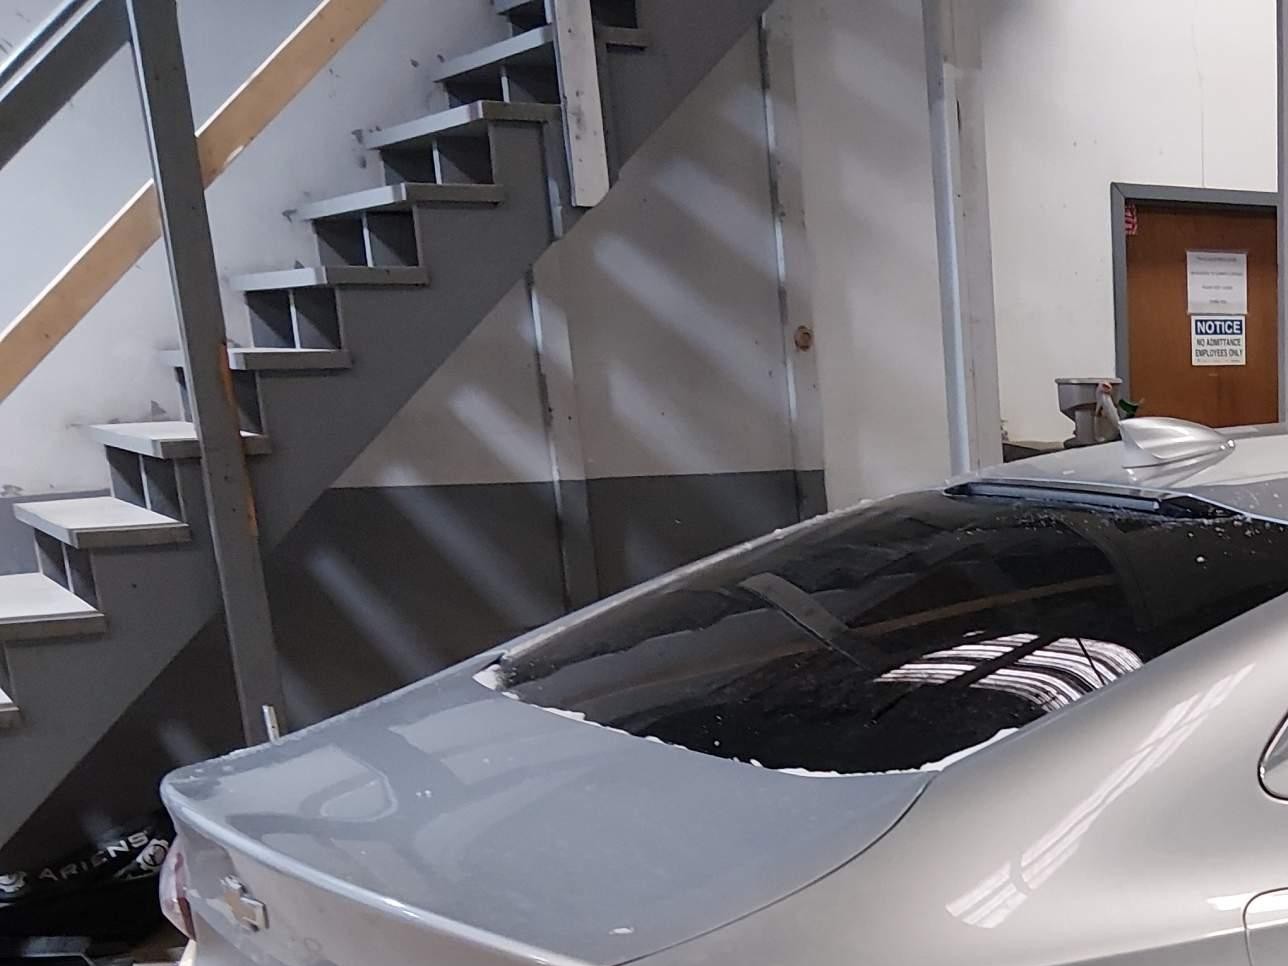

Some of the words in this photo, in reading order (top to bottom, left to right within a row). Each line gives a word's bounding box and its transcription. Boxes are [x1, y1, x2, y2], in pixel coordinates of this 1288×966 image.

[1196, 321, 1241, 334] NOTICE
[1196, 337, 1205, 347] NO
[1206, 337, 1241, 347] ADMITTANCE
[1195, 348, 1228, 358] EMPLOYEES
[1229, 348, 1243, 358] ONLY
[38, 831, 150, 881] ARIENS
